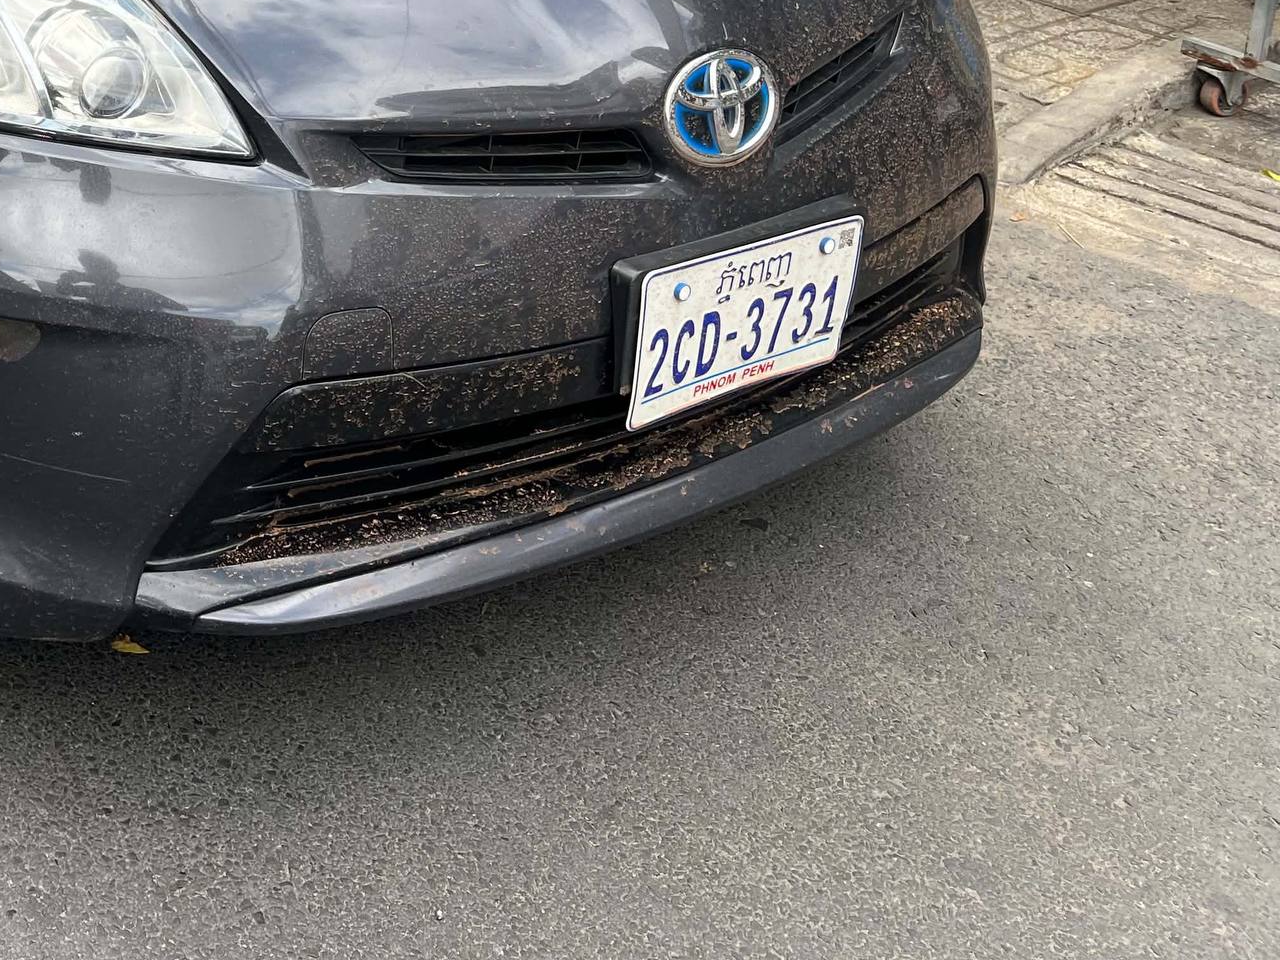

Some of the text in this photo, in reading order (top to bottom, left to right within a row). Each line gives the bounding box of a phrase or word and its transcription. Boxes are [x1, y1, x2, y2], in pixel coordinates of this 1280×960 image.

[716, 252, 793, 304] ភ្នំពេញ
[644, 275, 839, 398] 2CD-3731
[693, 360, 775, 397] PHNOM PENH
